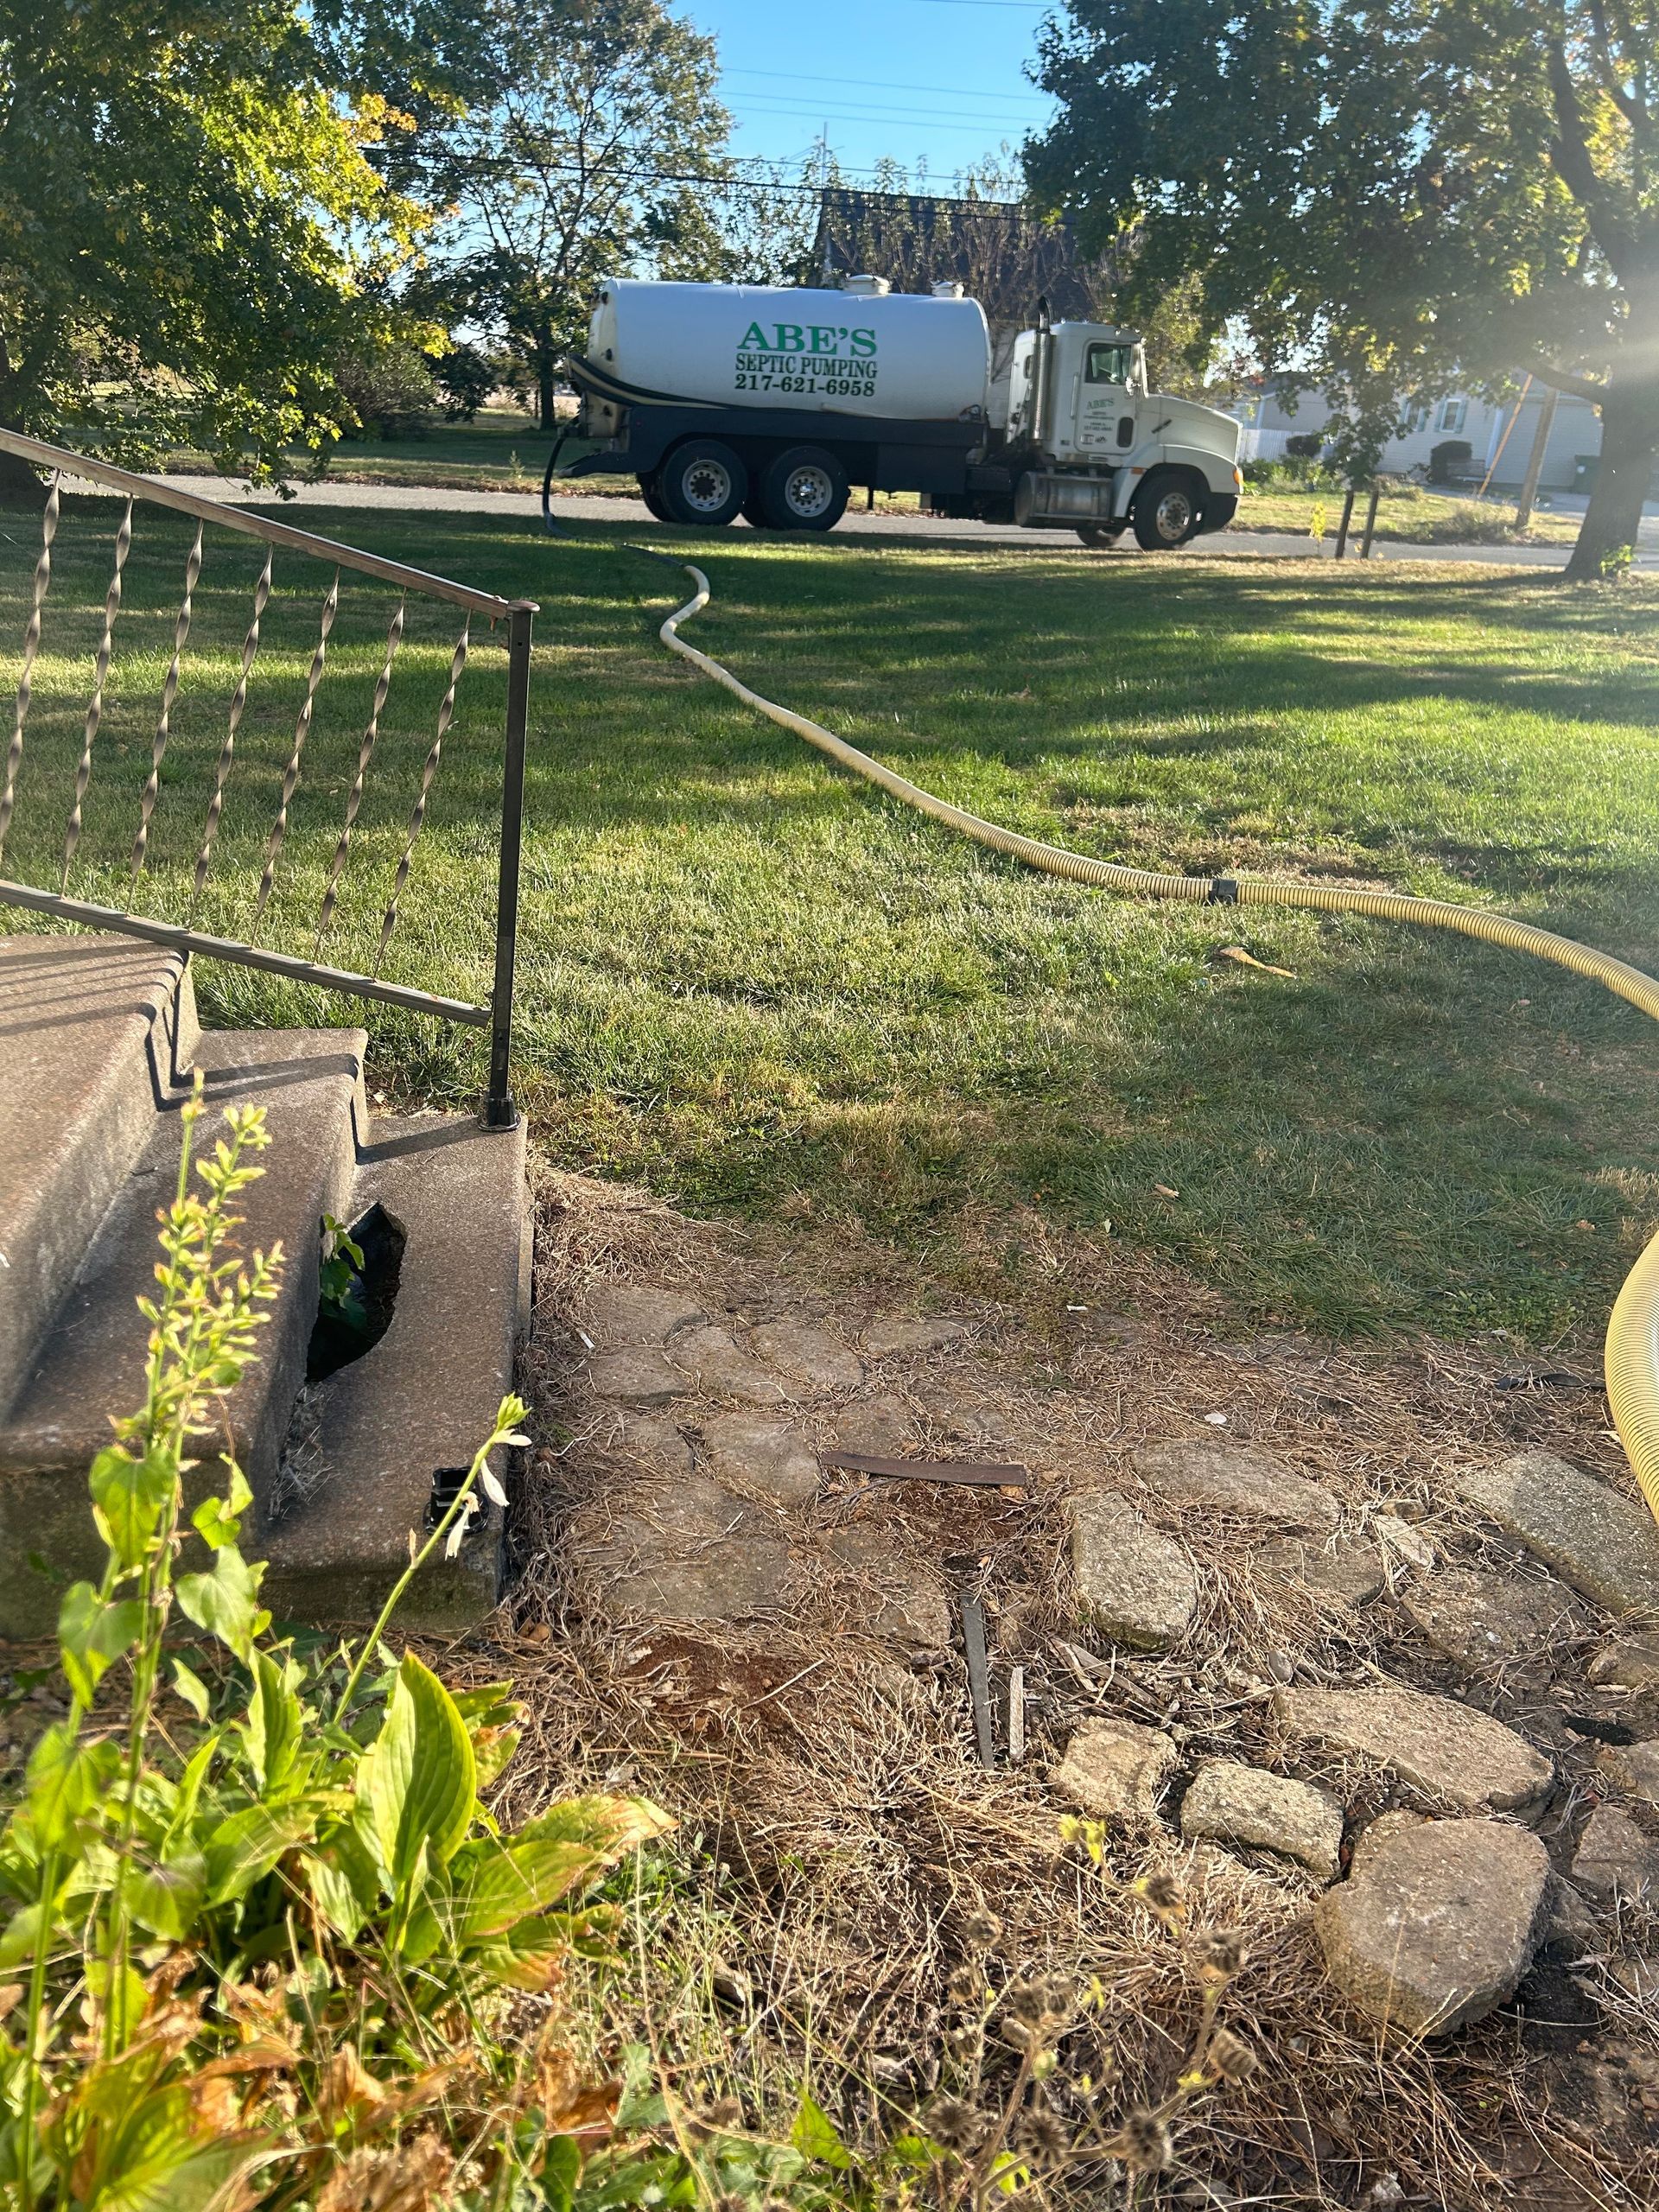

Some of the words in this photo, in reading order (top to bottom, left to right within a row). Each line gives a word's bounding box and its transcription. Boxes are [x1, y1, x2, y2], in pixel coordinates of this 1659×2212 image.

[736, 321, 878, 358] ABE'S
[735, 353, 796, 374] SEPTIC
[800, 357, 878, 378] PUMPING
[734, 373, 875, 397] 217-621-6958
